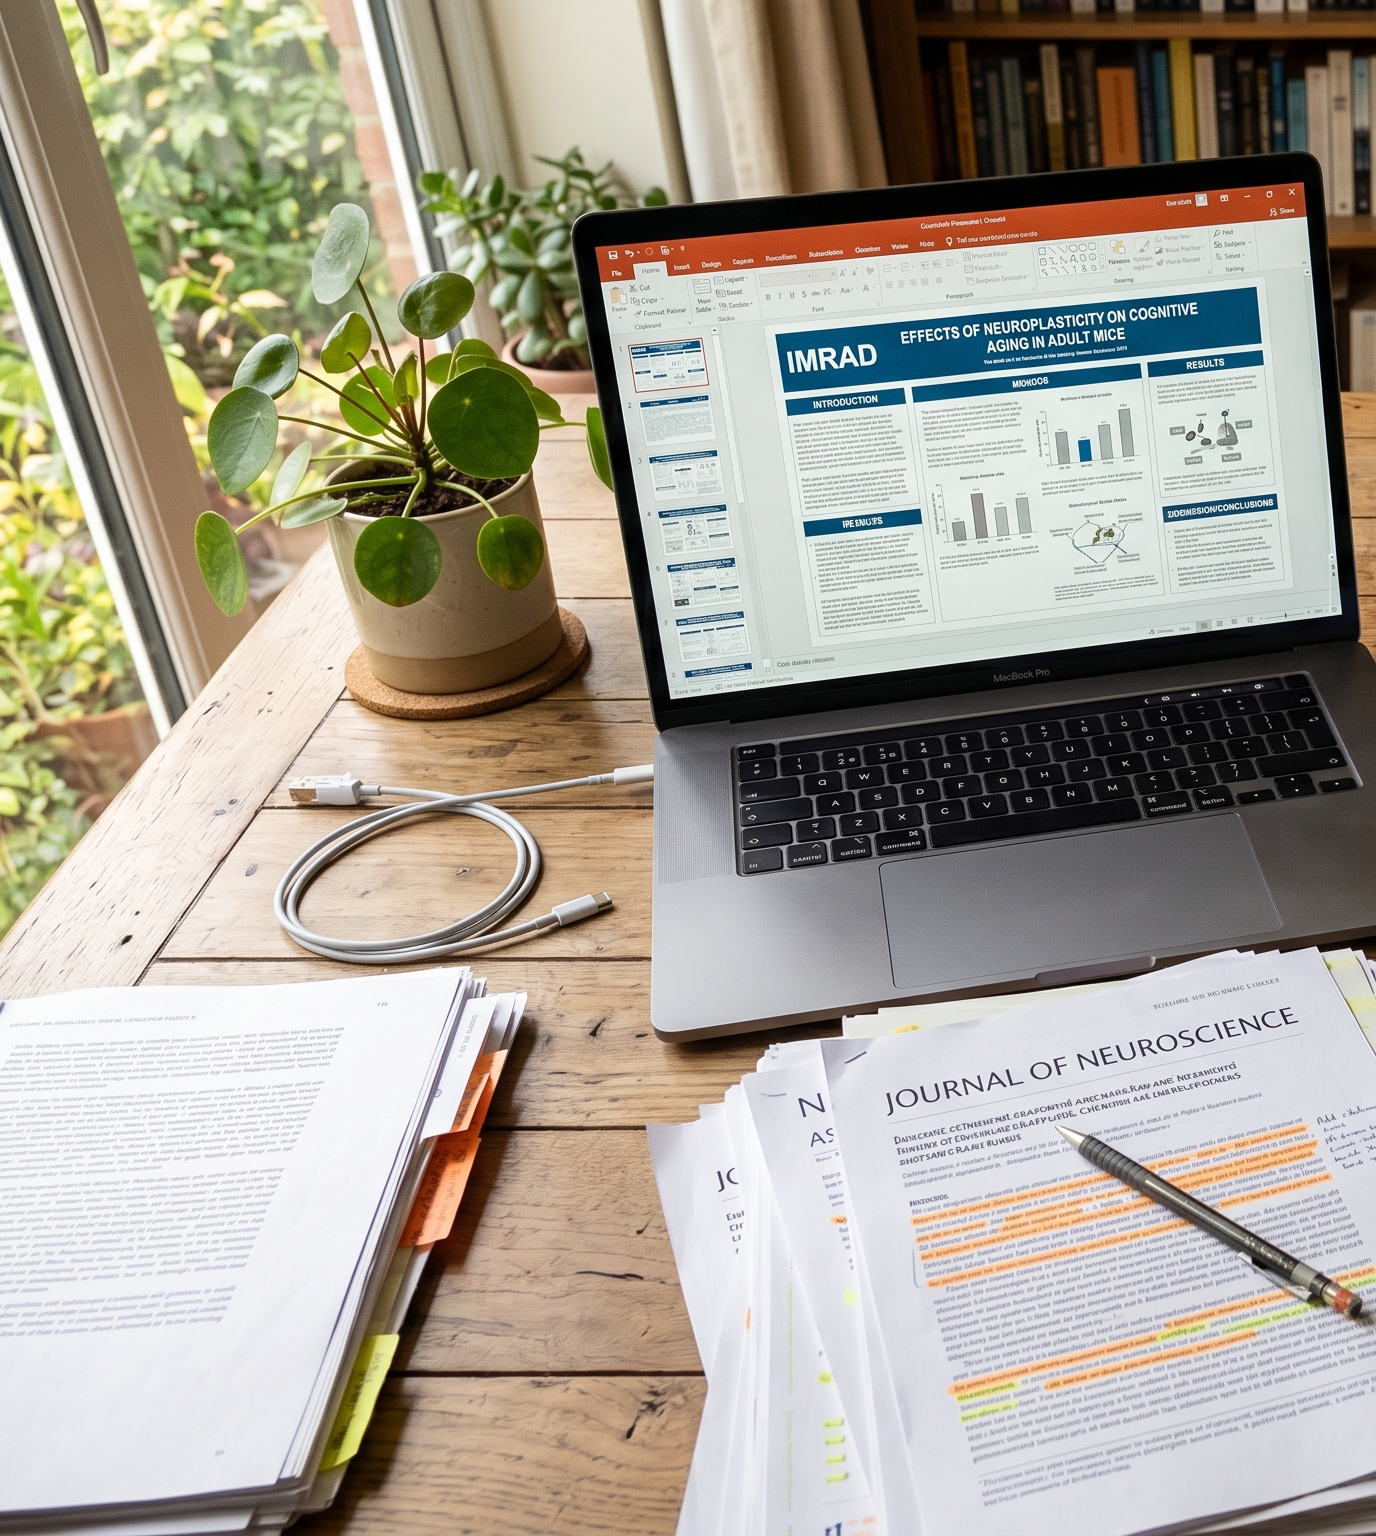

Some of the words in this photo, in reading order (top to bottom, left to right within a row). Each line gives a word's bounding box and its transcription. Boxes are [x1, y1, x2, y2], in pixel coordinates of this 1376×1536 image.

[786, 343, 878, 374] IMRAD
[900, 322, 959, 345] EFFECTS
[963, 323, 980, 338] OF
[983, 311, 1104, 336] NEUROPLASTICITY
[1107, 309, 1126, 323] ON
[1129, 302, 1199, 322] COGNITIVE
[987, 339, 1029, 354] AGING
[1032, 336, 1045, 348] IN
[1048, 330, 1090, 347] ADULT
[1094, 327, 1126, 342] MICE
[1186, 357, 1225, 371] RESULTS
[812, 394, 879, 409] INTRODUCTION
[1036, 668, 1050, 679] Pro
[898, 813, 906, 821] X
[885, 1067, 1024, 1116] JOURNAL
[1029, 1055, 1068, 1080] OF
[1077, 1006, 1299, 1071] NEUROSCIENCE
